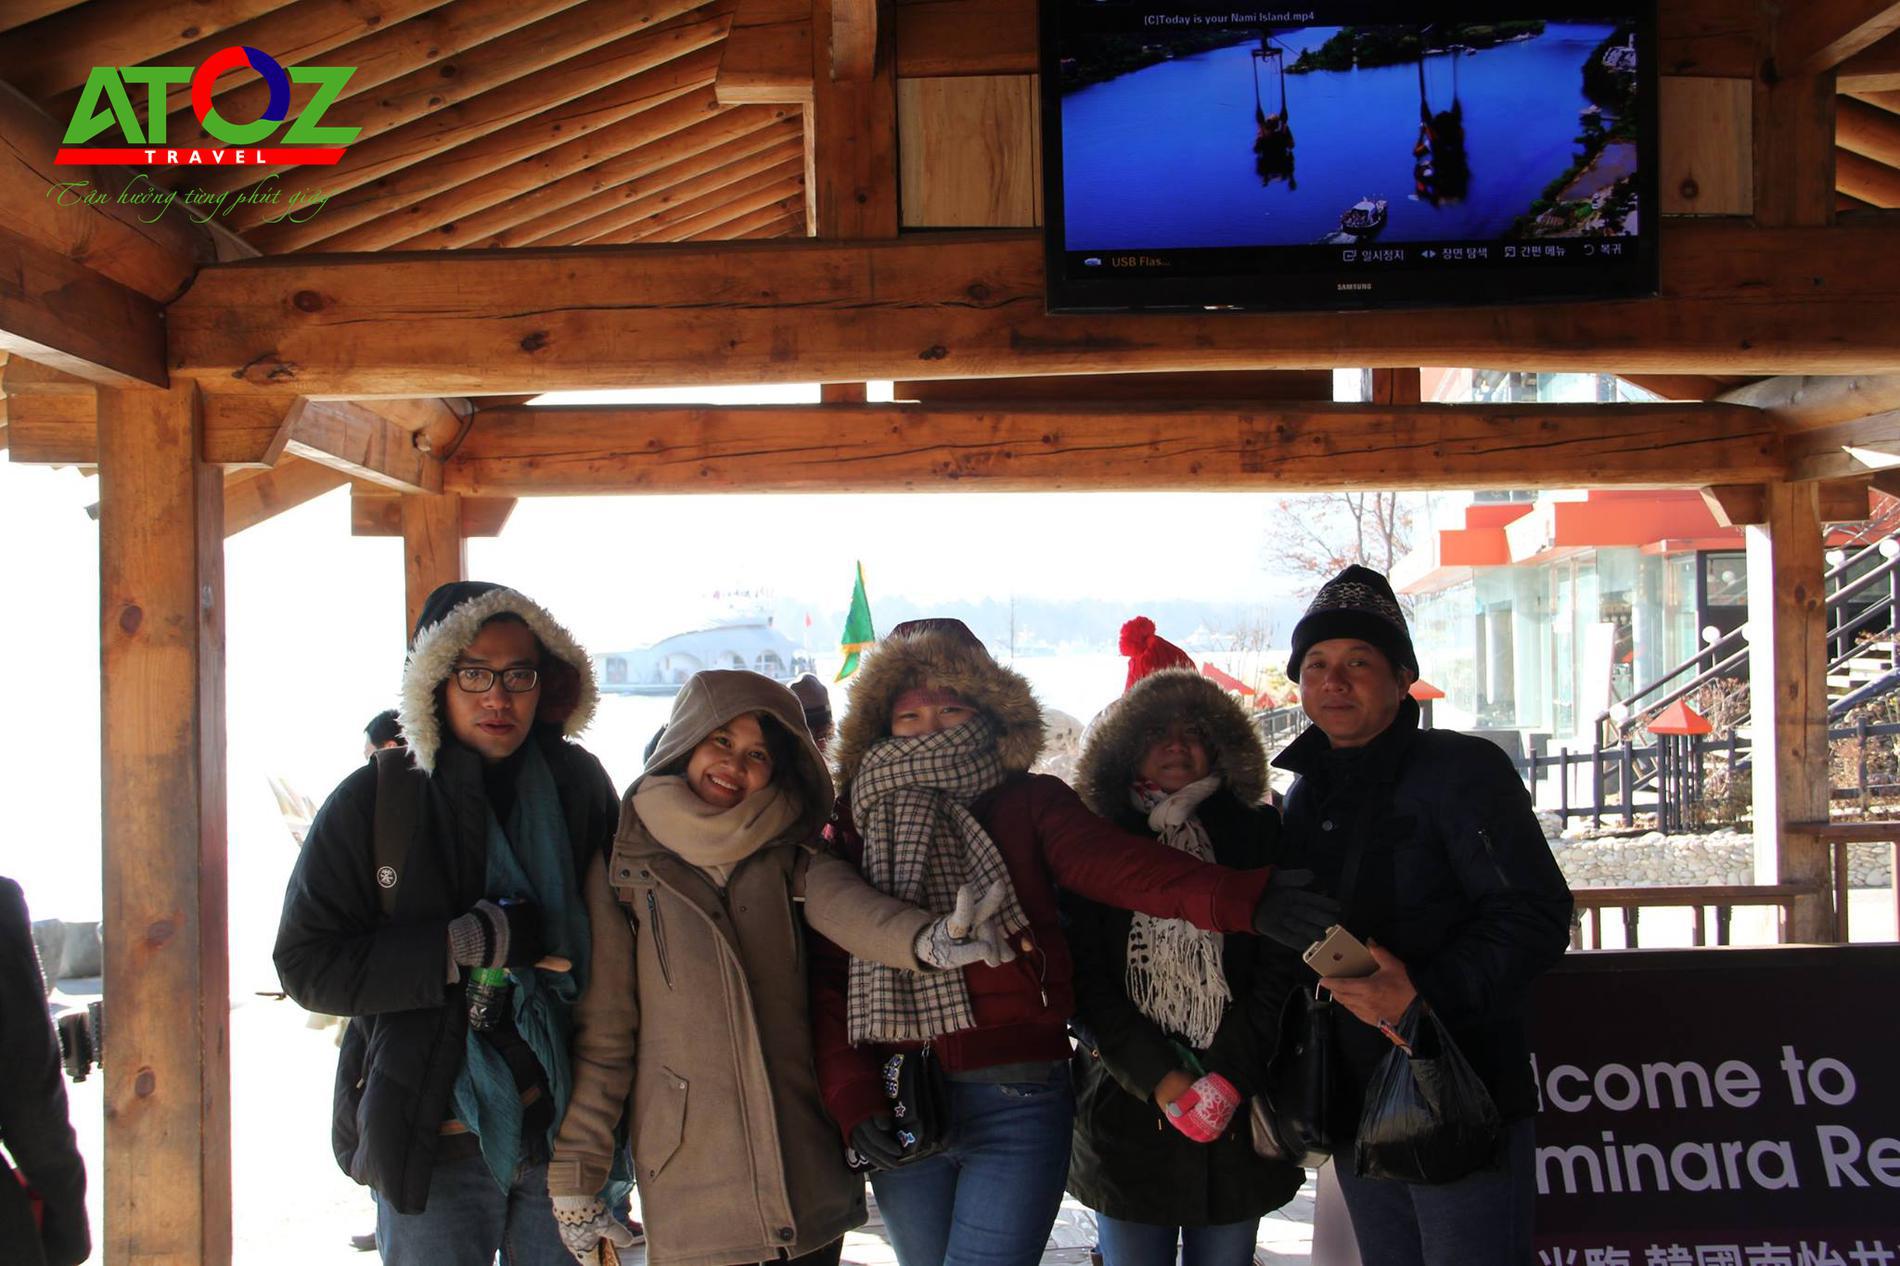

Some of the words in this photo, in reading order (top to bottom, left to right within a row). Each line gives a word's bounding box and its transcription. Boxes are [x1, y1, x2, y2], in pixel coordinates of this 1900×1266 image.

[1193, 14, 1203, 23] is
[1205, 14, 1229, 25] your
[1231, 12, 1256, 23] Nami
[1259, 11, 1315, 23] Island.mp4
[1361, 248, 1405, 263] 일시정지
[1442, 247, 1464, 261] 장면
[1466, 246, 1489, 260] 탐색
[1520, 245, 1543, 259] 간편
[1544, 244, 1567, 258] 메뉴
[1600, 243, 1623, 257] 복귀
[1112, 256, 1137, 268] USB
[1336, 282, 1373, 291] SAMSUNG
[1780, 1045, 1857, 1106] to
